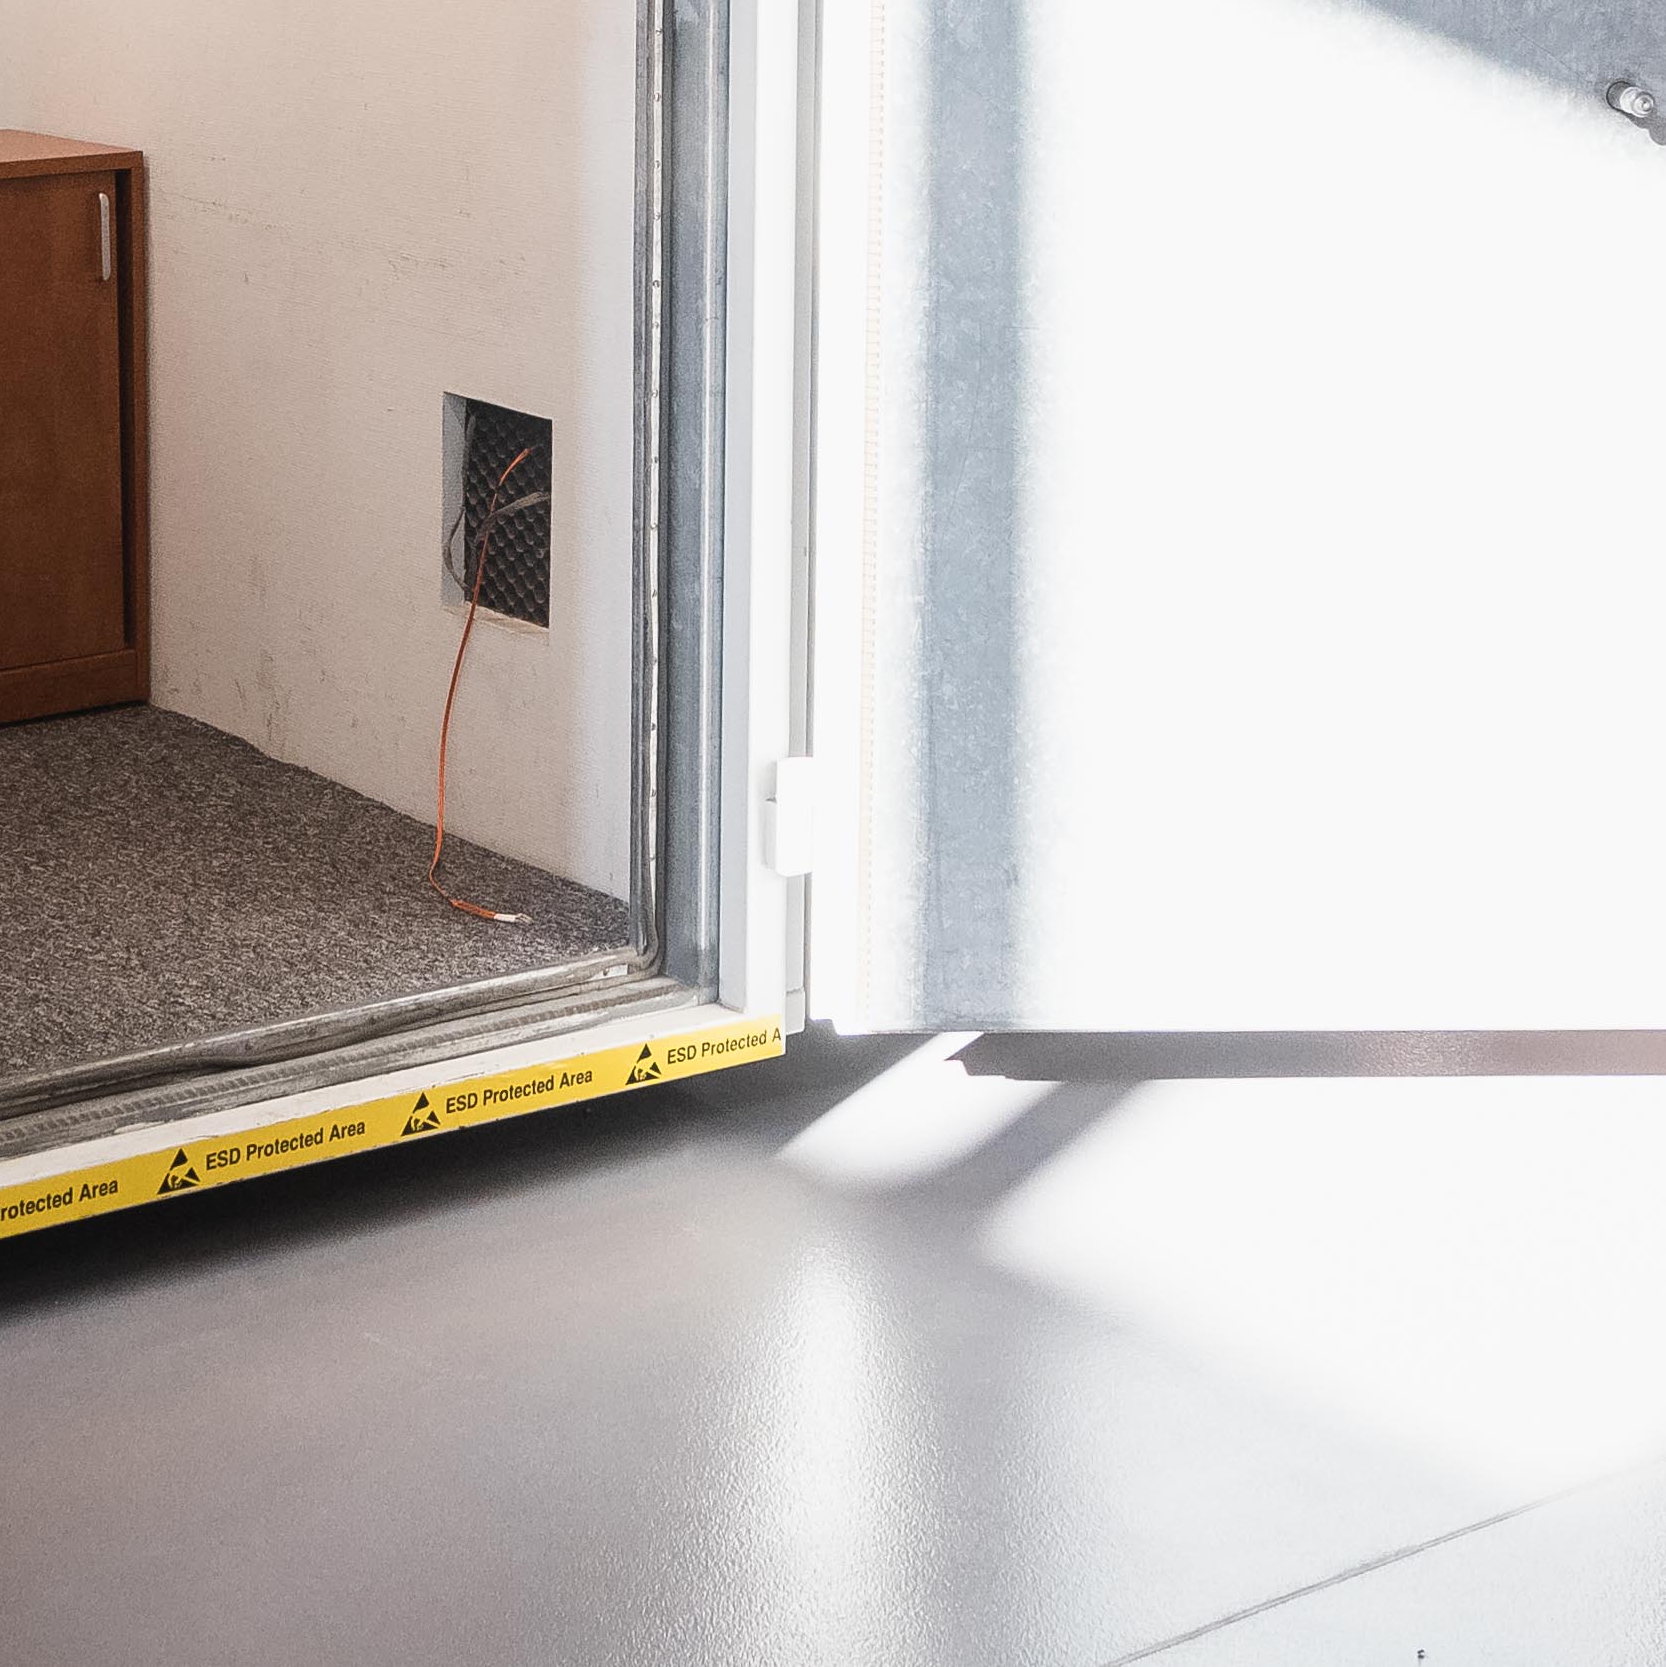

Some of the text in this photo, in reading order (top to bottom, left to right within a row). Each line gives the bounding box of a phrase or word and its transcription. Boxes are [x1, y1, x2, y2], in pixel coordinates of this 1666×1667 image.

[667, 1045, 697, 1065] ESD
[701, 1030, 767, 1057] Protected
[446, 1070, 593, 1114] ESD Protected Area
[206, 1121, 366, 1171] ESD Protected Area
[79, 1180, 119, 1201] Area
